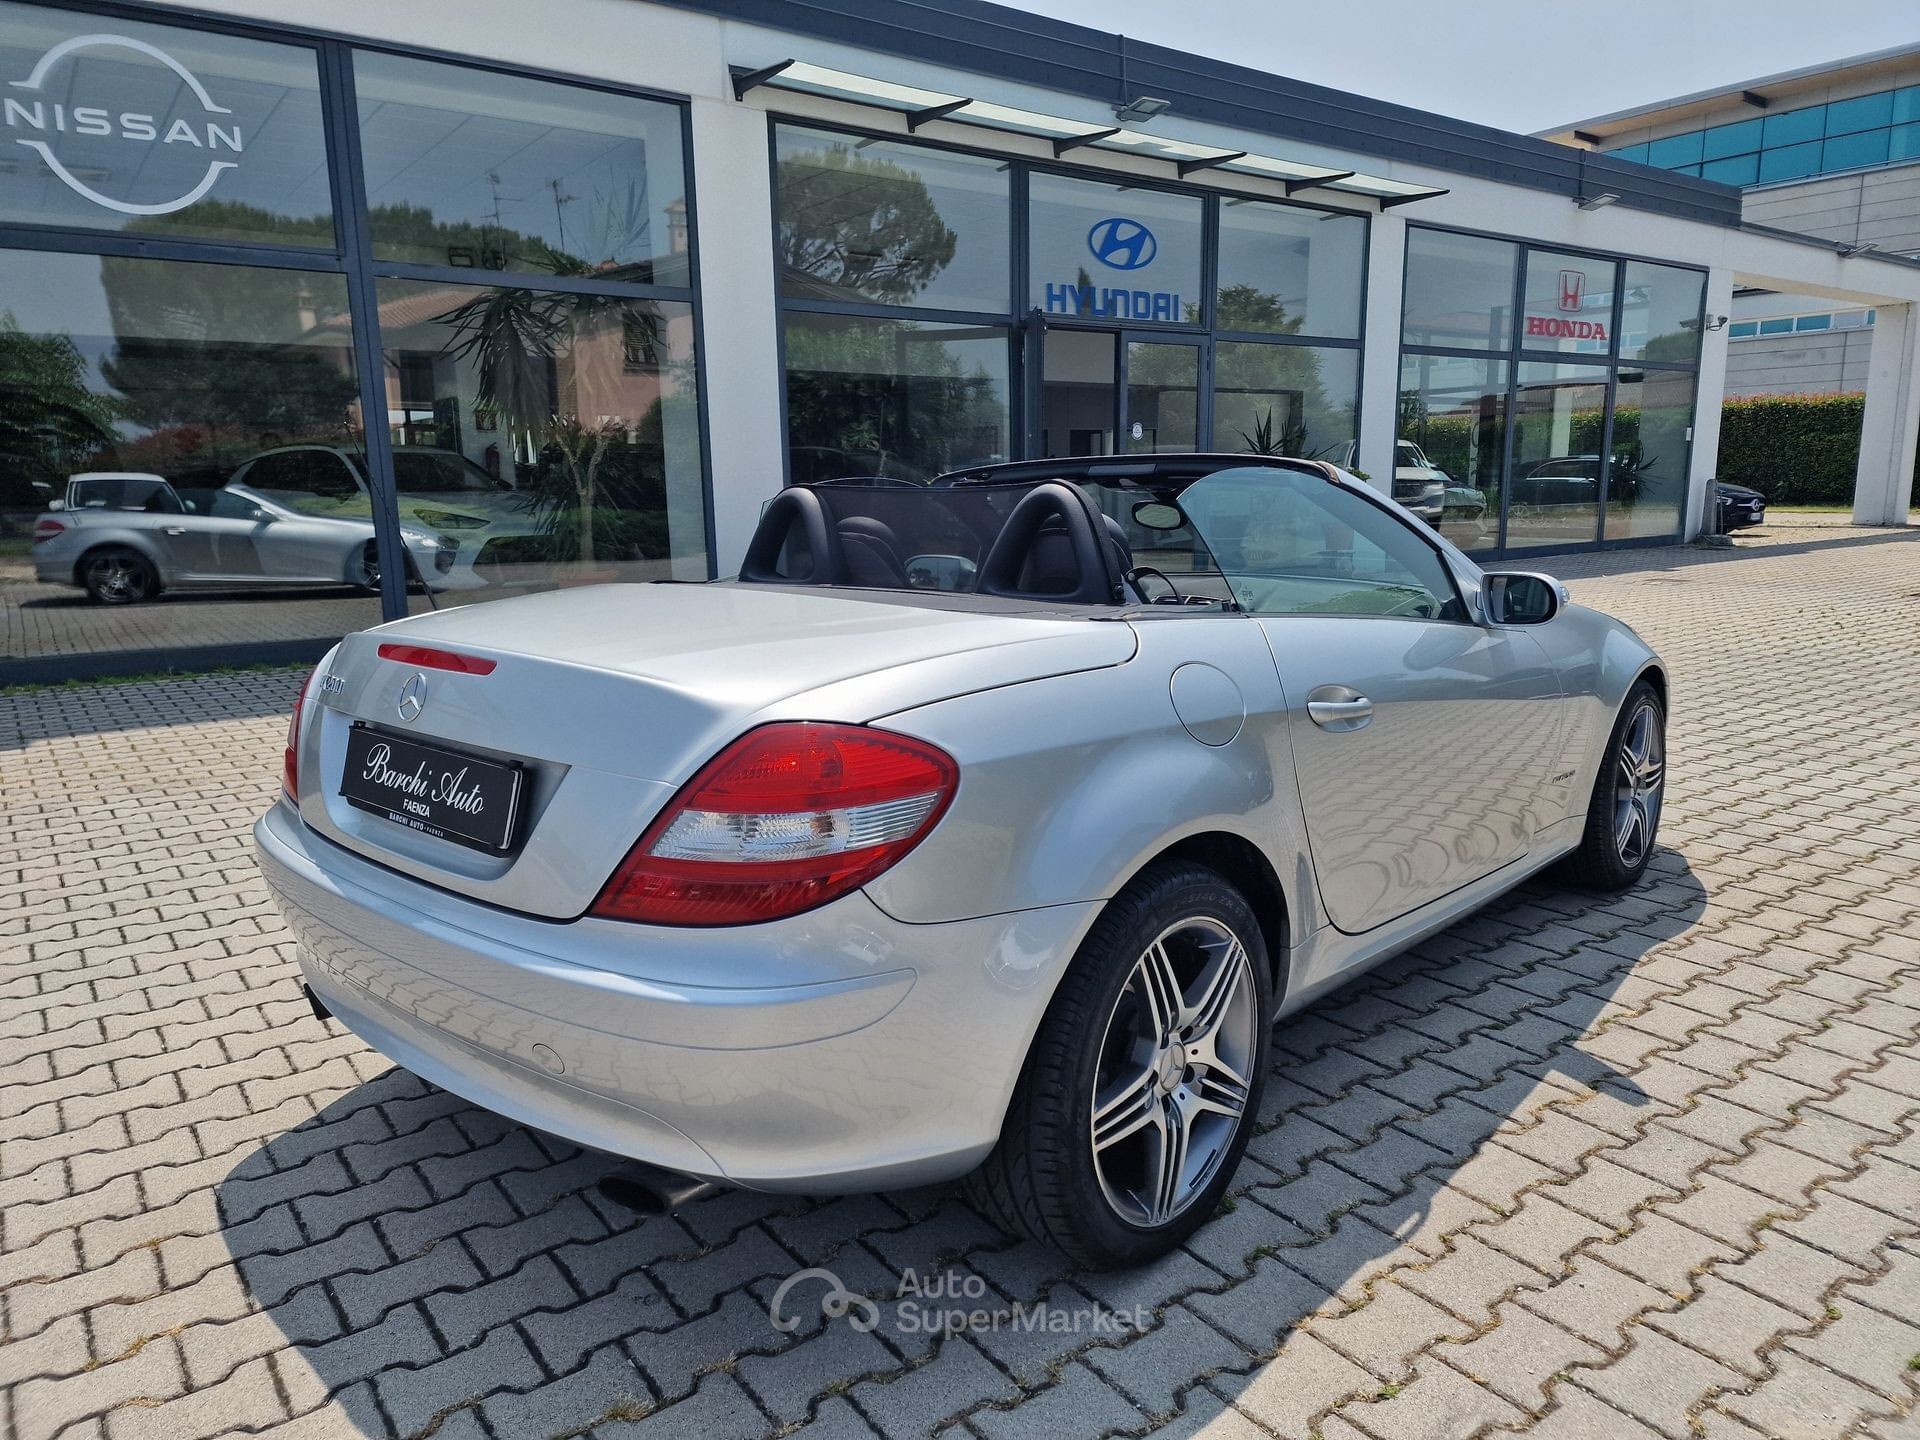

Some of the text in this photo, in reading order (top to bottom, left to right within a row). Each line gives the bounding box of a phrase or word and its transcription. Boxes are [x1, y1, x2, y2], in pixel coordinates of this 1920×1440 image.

[4, 98, 243, 152] NISSAN
[1046, 283, 1179, 321] HYUNDAI
[1526, 317, 1607, 340] HONDA
[363, 743, 484, 815] Barchi Auto
[389, 813, 408, 825] BARCHI
[409, 820, 424, 831] AUTO
[403, 799, 430, 817] FAENZA
